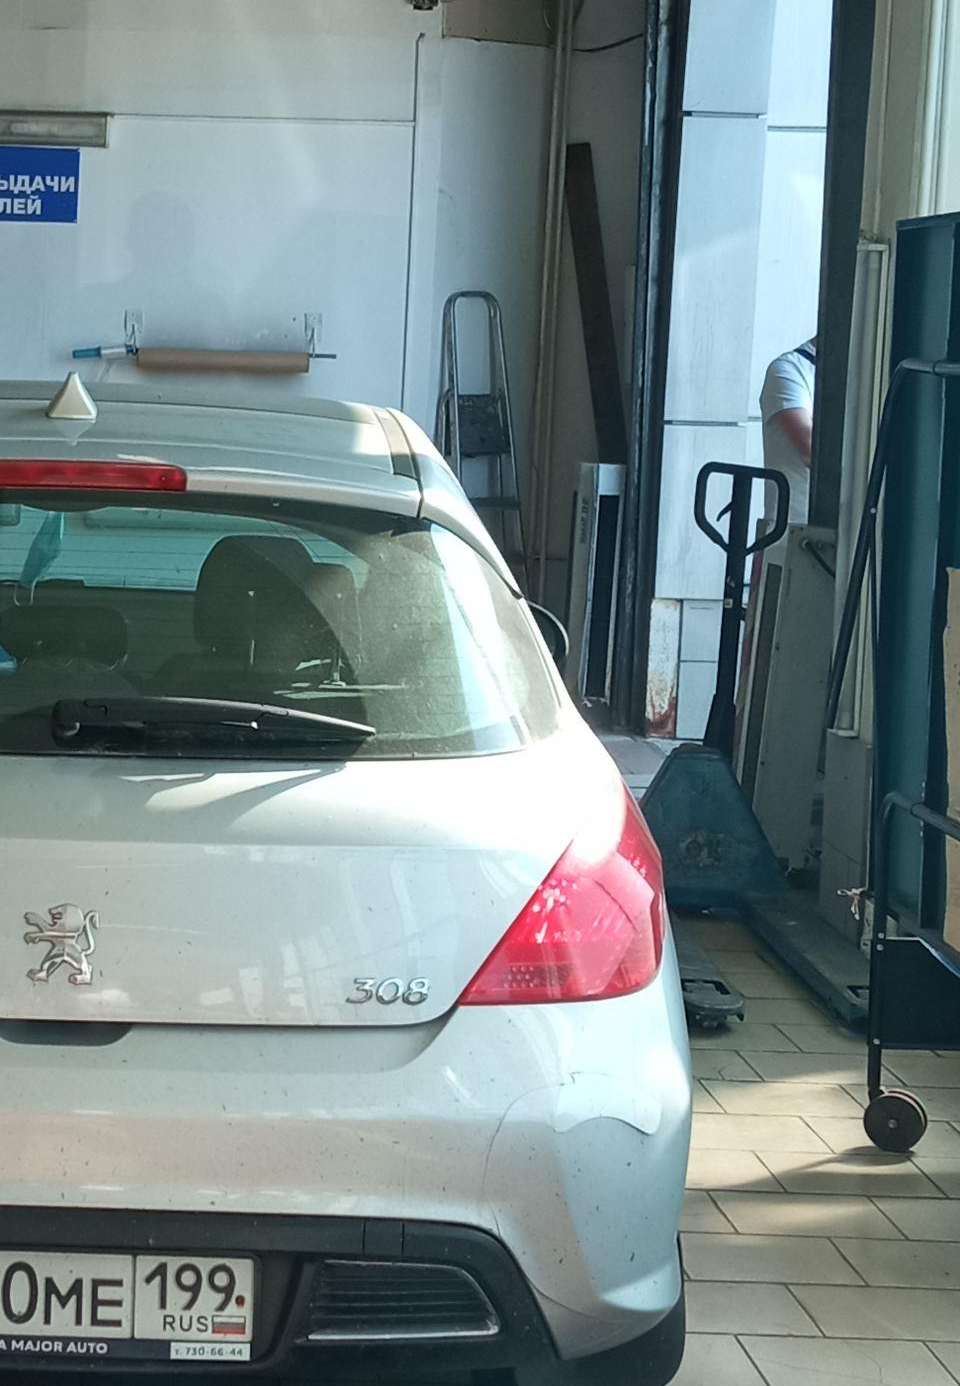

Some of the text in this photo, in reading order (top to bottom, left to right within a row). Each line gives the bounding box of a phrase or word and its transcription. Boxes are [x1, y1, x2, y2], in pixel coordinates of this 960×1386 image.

[344, 977, 430, 1006] 308
[144, 1261, 236, 1312] 199
[162, 1314, 209, 1333] RUS
[11, 1340, 63, 1353] MAJOR
[66, 1342, 109, 1355] AUTO
